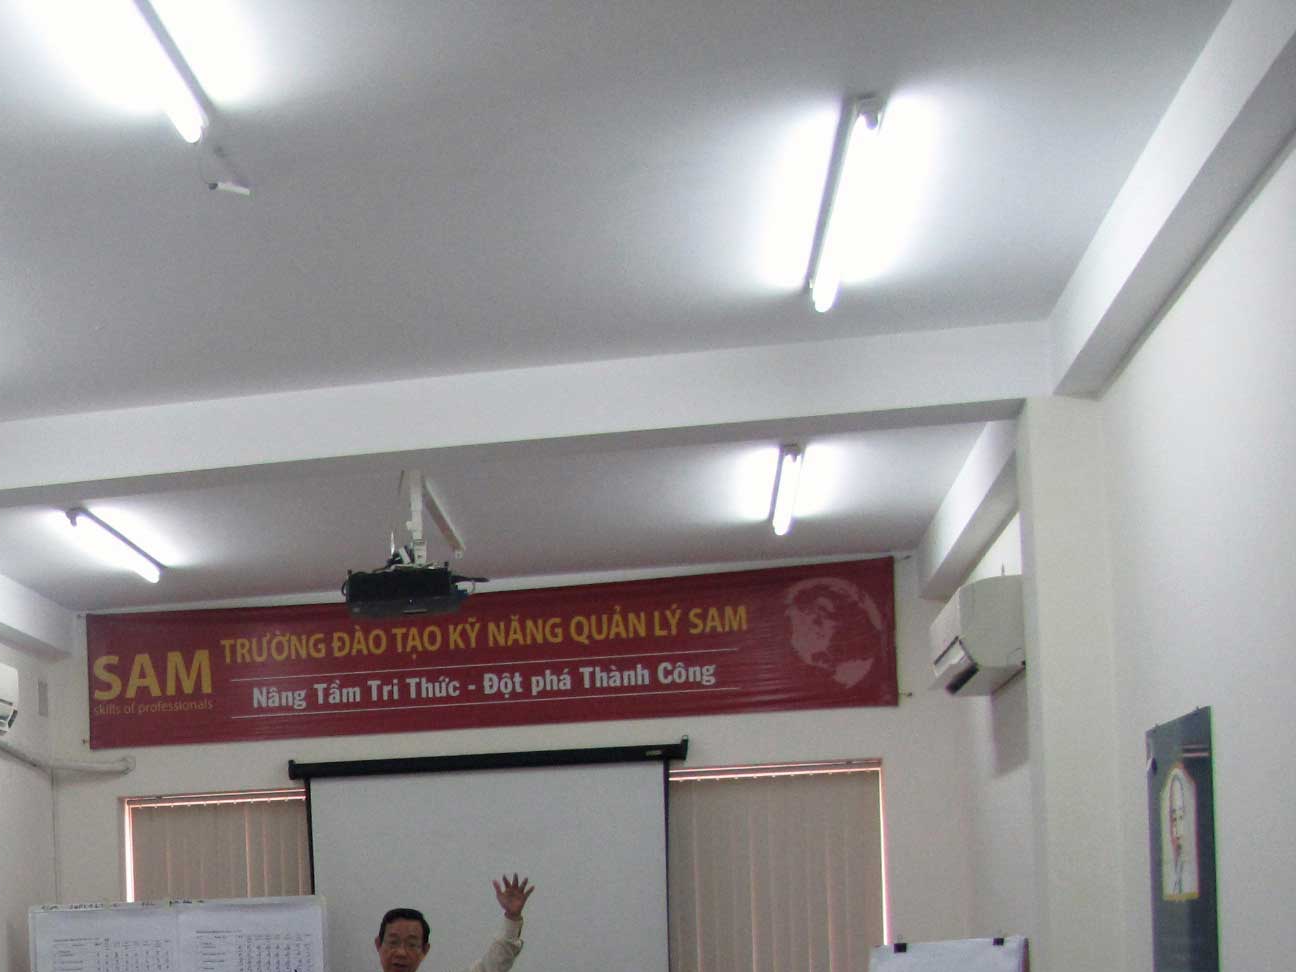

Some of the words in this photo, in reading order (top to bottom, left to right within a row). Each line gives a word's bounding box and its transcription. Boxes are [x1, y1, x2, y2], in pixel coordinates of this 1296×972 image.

[220, 631, 328, 664] TRƯỜNG
[332, 626, 387, 657] ĐÀO
[391, 626, 442, 660] TẠO
[448, 618, 481, 650] KỸ
[488, 614, 564, 647] NĂNG
[569, 604, 647, 645] QUẢN
[653, 604, 682, 637] LÝ
[688, 605, 749, 635] SAM
[93, 649, 213, 700] SAM
[253, 687, 307, 709] Nâng
[313, 679, 360, 705] Tầm
[367, 679, 400, 701] Tri
[406, 675, 460, 699] Thức
[483, 672, 523, 699] Đột
[530, 668, 572, 696] phá
[579, 663, 650, 689] Thành
[657, 662, 717, 686] Công
[94, 702, 122, 716] skills
[124, 702, 136, 715] of
[138, 699, 214, 716] professionals
